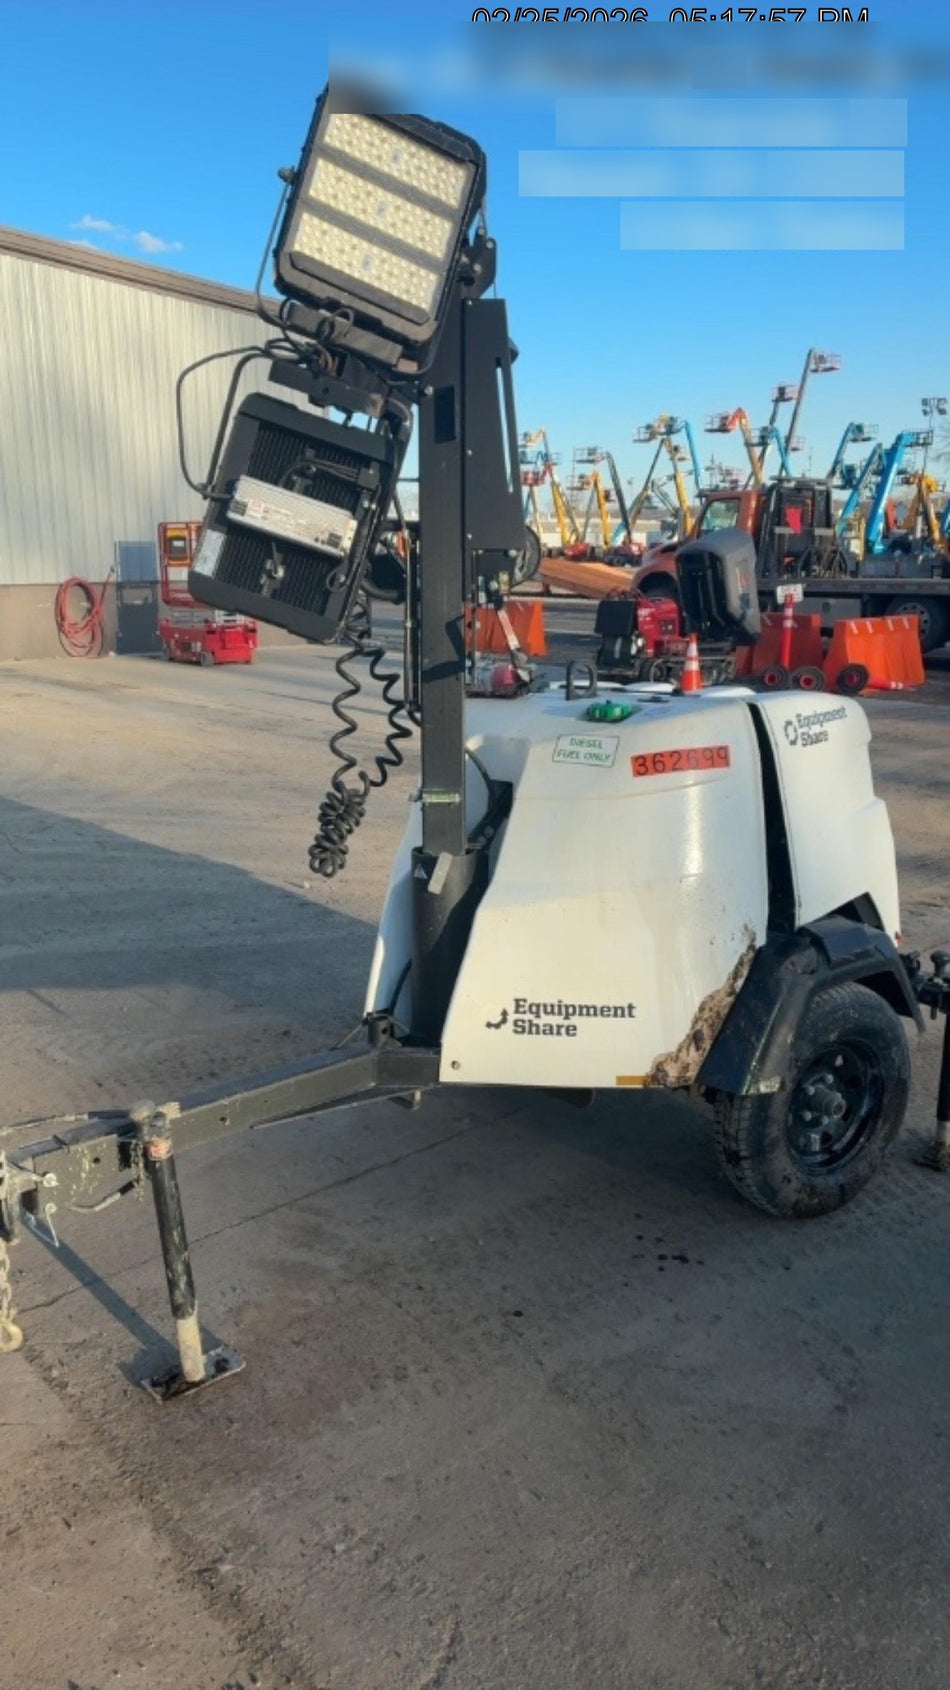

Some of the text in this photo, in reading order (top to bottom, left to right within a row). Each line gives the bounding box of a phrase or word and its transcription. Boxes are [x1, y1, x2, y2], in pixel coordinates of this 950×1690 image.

[795, 705, 848, 731] Equipment
[569, 737, 603, 749] DIESEL
[800, 730, 829, 748] Share
[557, 748, 612, 763] FUEL ONLY
[633, 746, 730, 776] 362699
[512, 998, 637, 1021] Equipment
[512, 1018, 578, 1038] Share
